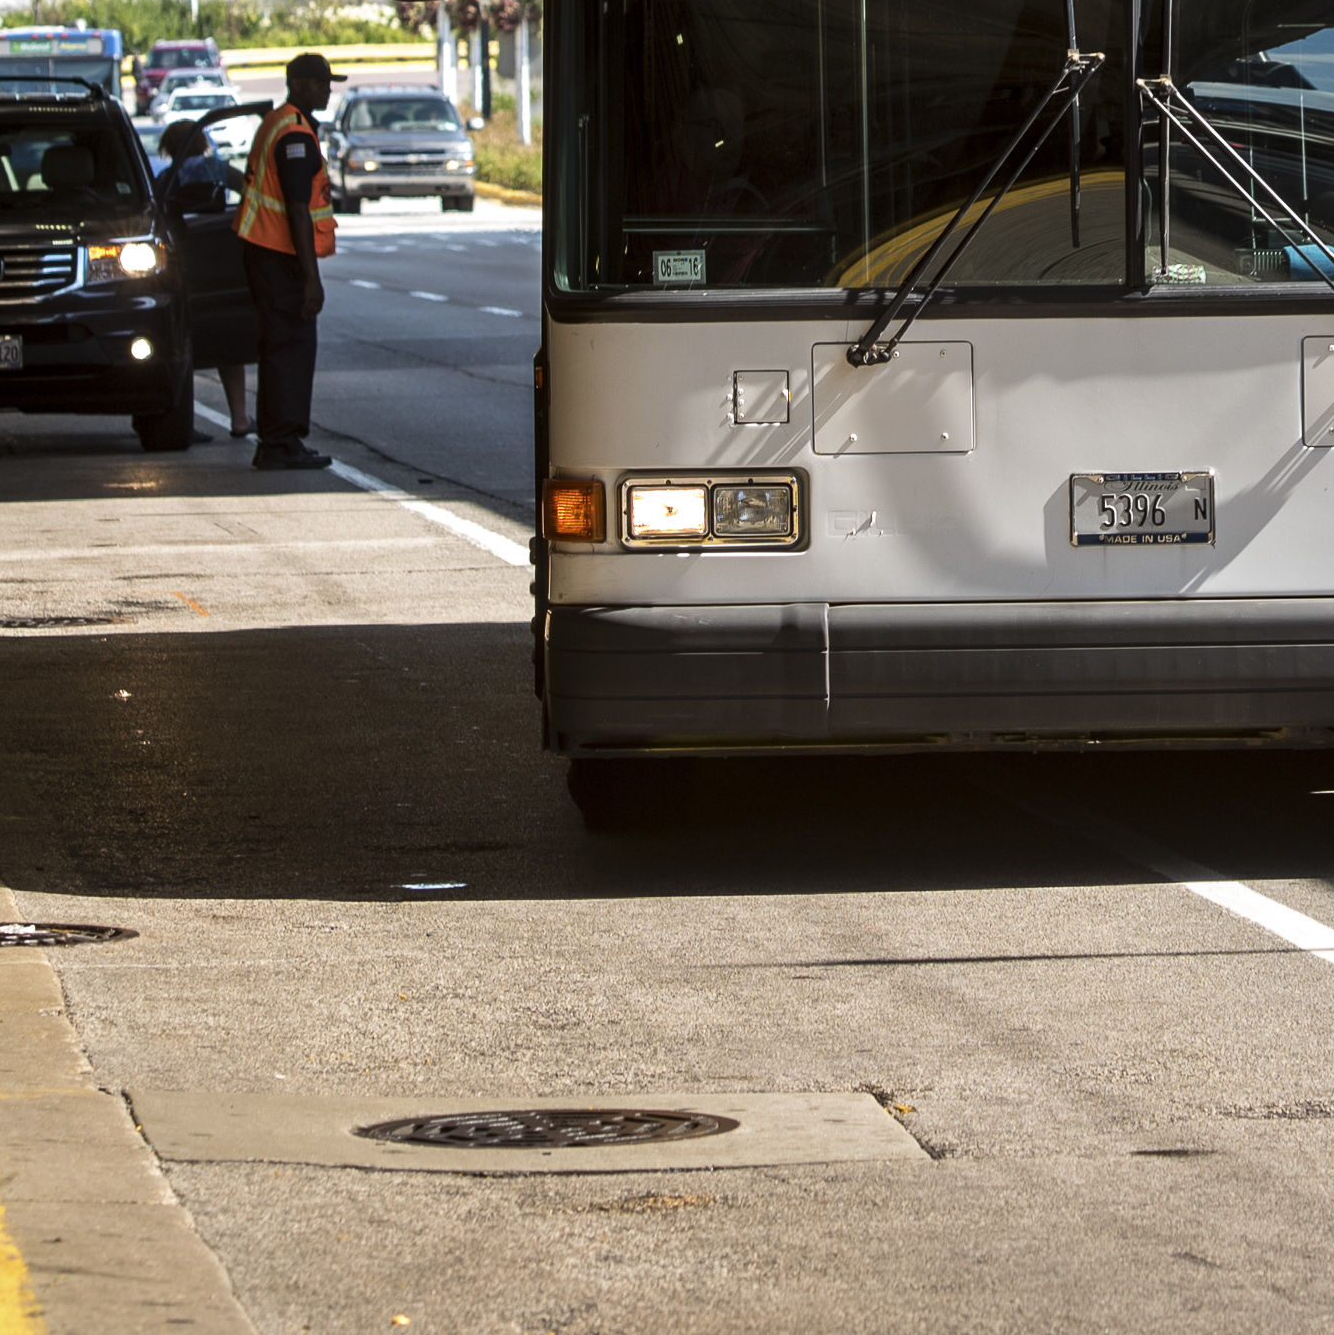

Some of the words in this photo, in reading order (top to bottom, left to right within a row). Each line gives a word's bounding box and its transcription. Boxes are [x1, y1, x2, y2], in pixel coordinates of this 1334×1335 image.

[661, 258, 672, 277] 06
[688, 257, 699, 276] 16
[1104, 481, 1180, 492] Illinois
[1100, 493, 1166, 528] 5396
[1194, 497, 1208, 521] N
[1104, 534, 1137, 544] MADE
[1142, 534, 1154, 544] IN
[1157, 533, 1182, 543] USA
